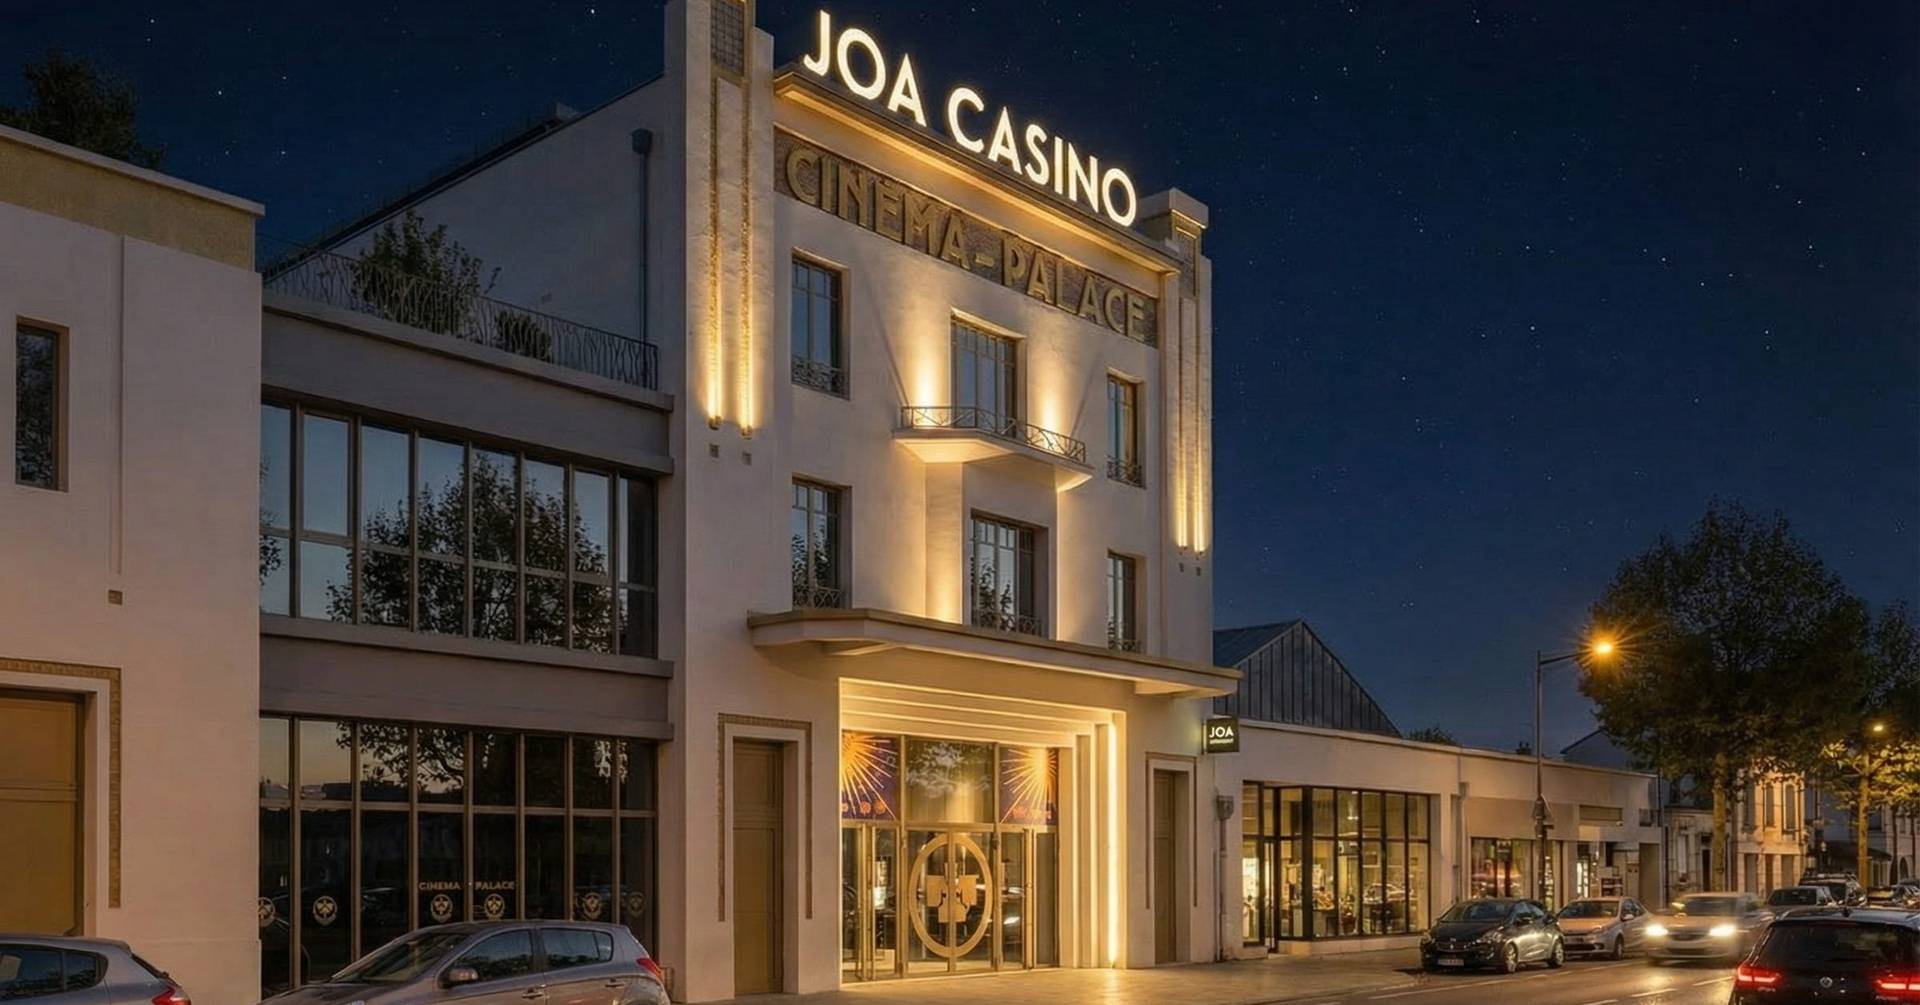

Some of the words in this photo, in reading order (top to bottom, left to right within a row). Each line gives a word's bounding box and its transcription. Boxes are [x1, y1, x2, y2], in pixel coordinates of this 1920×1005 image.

[803, 10, 927, 127] JOA
[948, 87, 1137, 227] CASINO
[1209, 726, 1234, 738] JOA
[419, 881, 461, 891] CINEMA
[475, 880, 515, 890] PALACE
